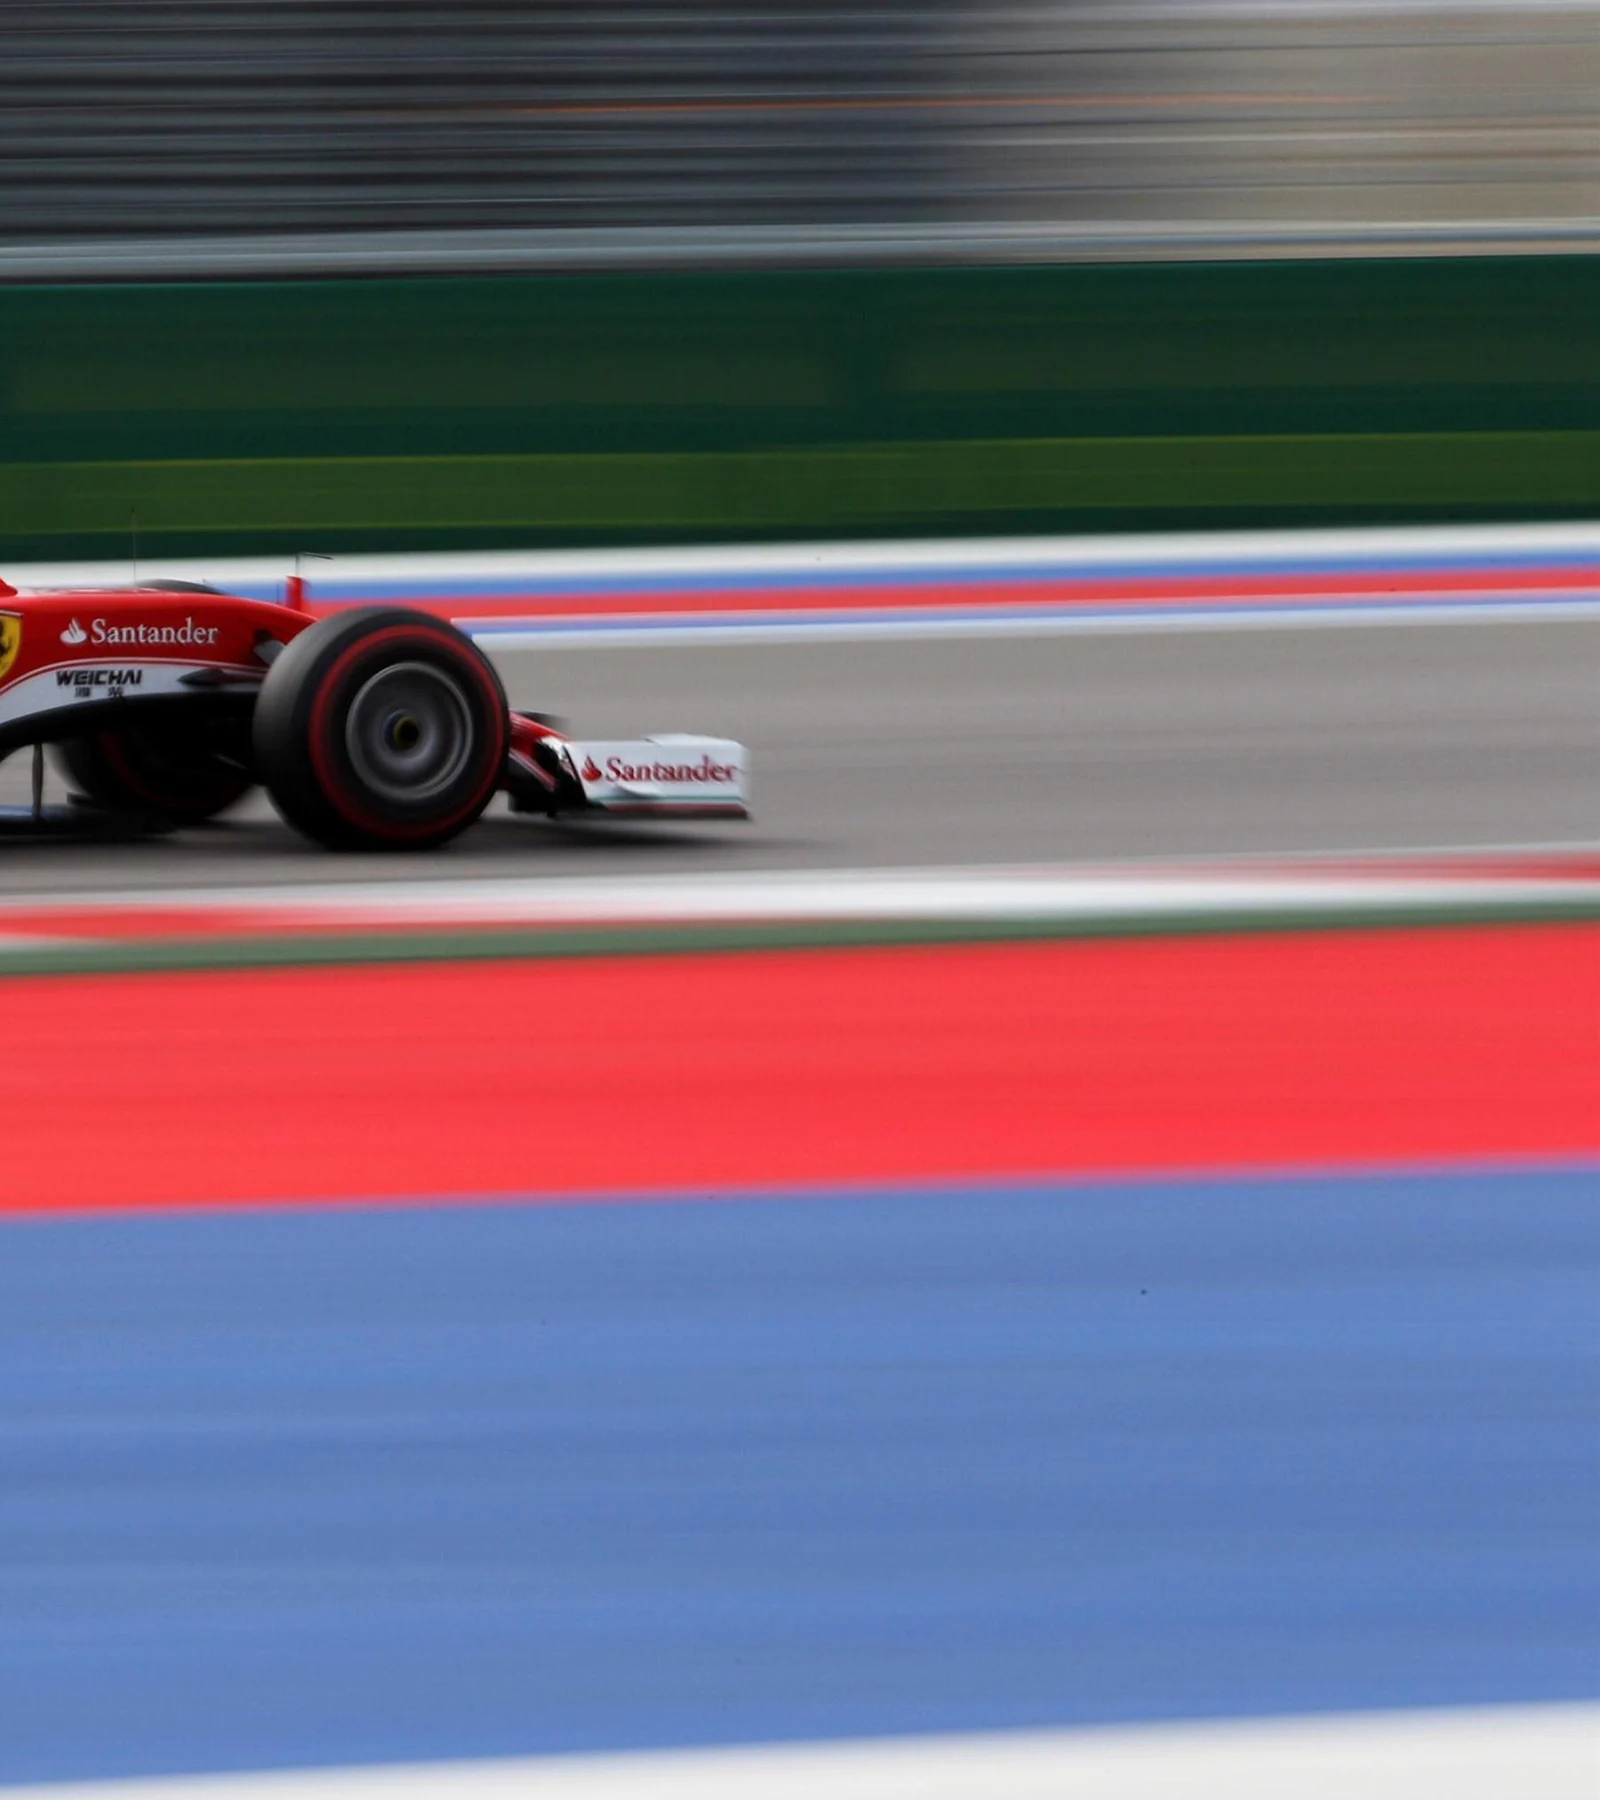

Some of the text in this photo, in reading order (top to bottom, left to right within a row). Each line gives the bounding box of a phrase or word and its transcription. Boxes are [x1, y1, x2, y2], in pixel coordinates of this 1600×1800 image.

[90, 616, 219, 645] Santander
[56, 669, 142, 686] WEICHAI
[605, 753, 737, 783] Santander
